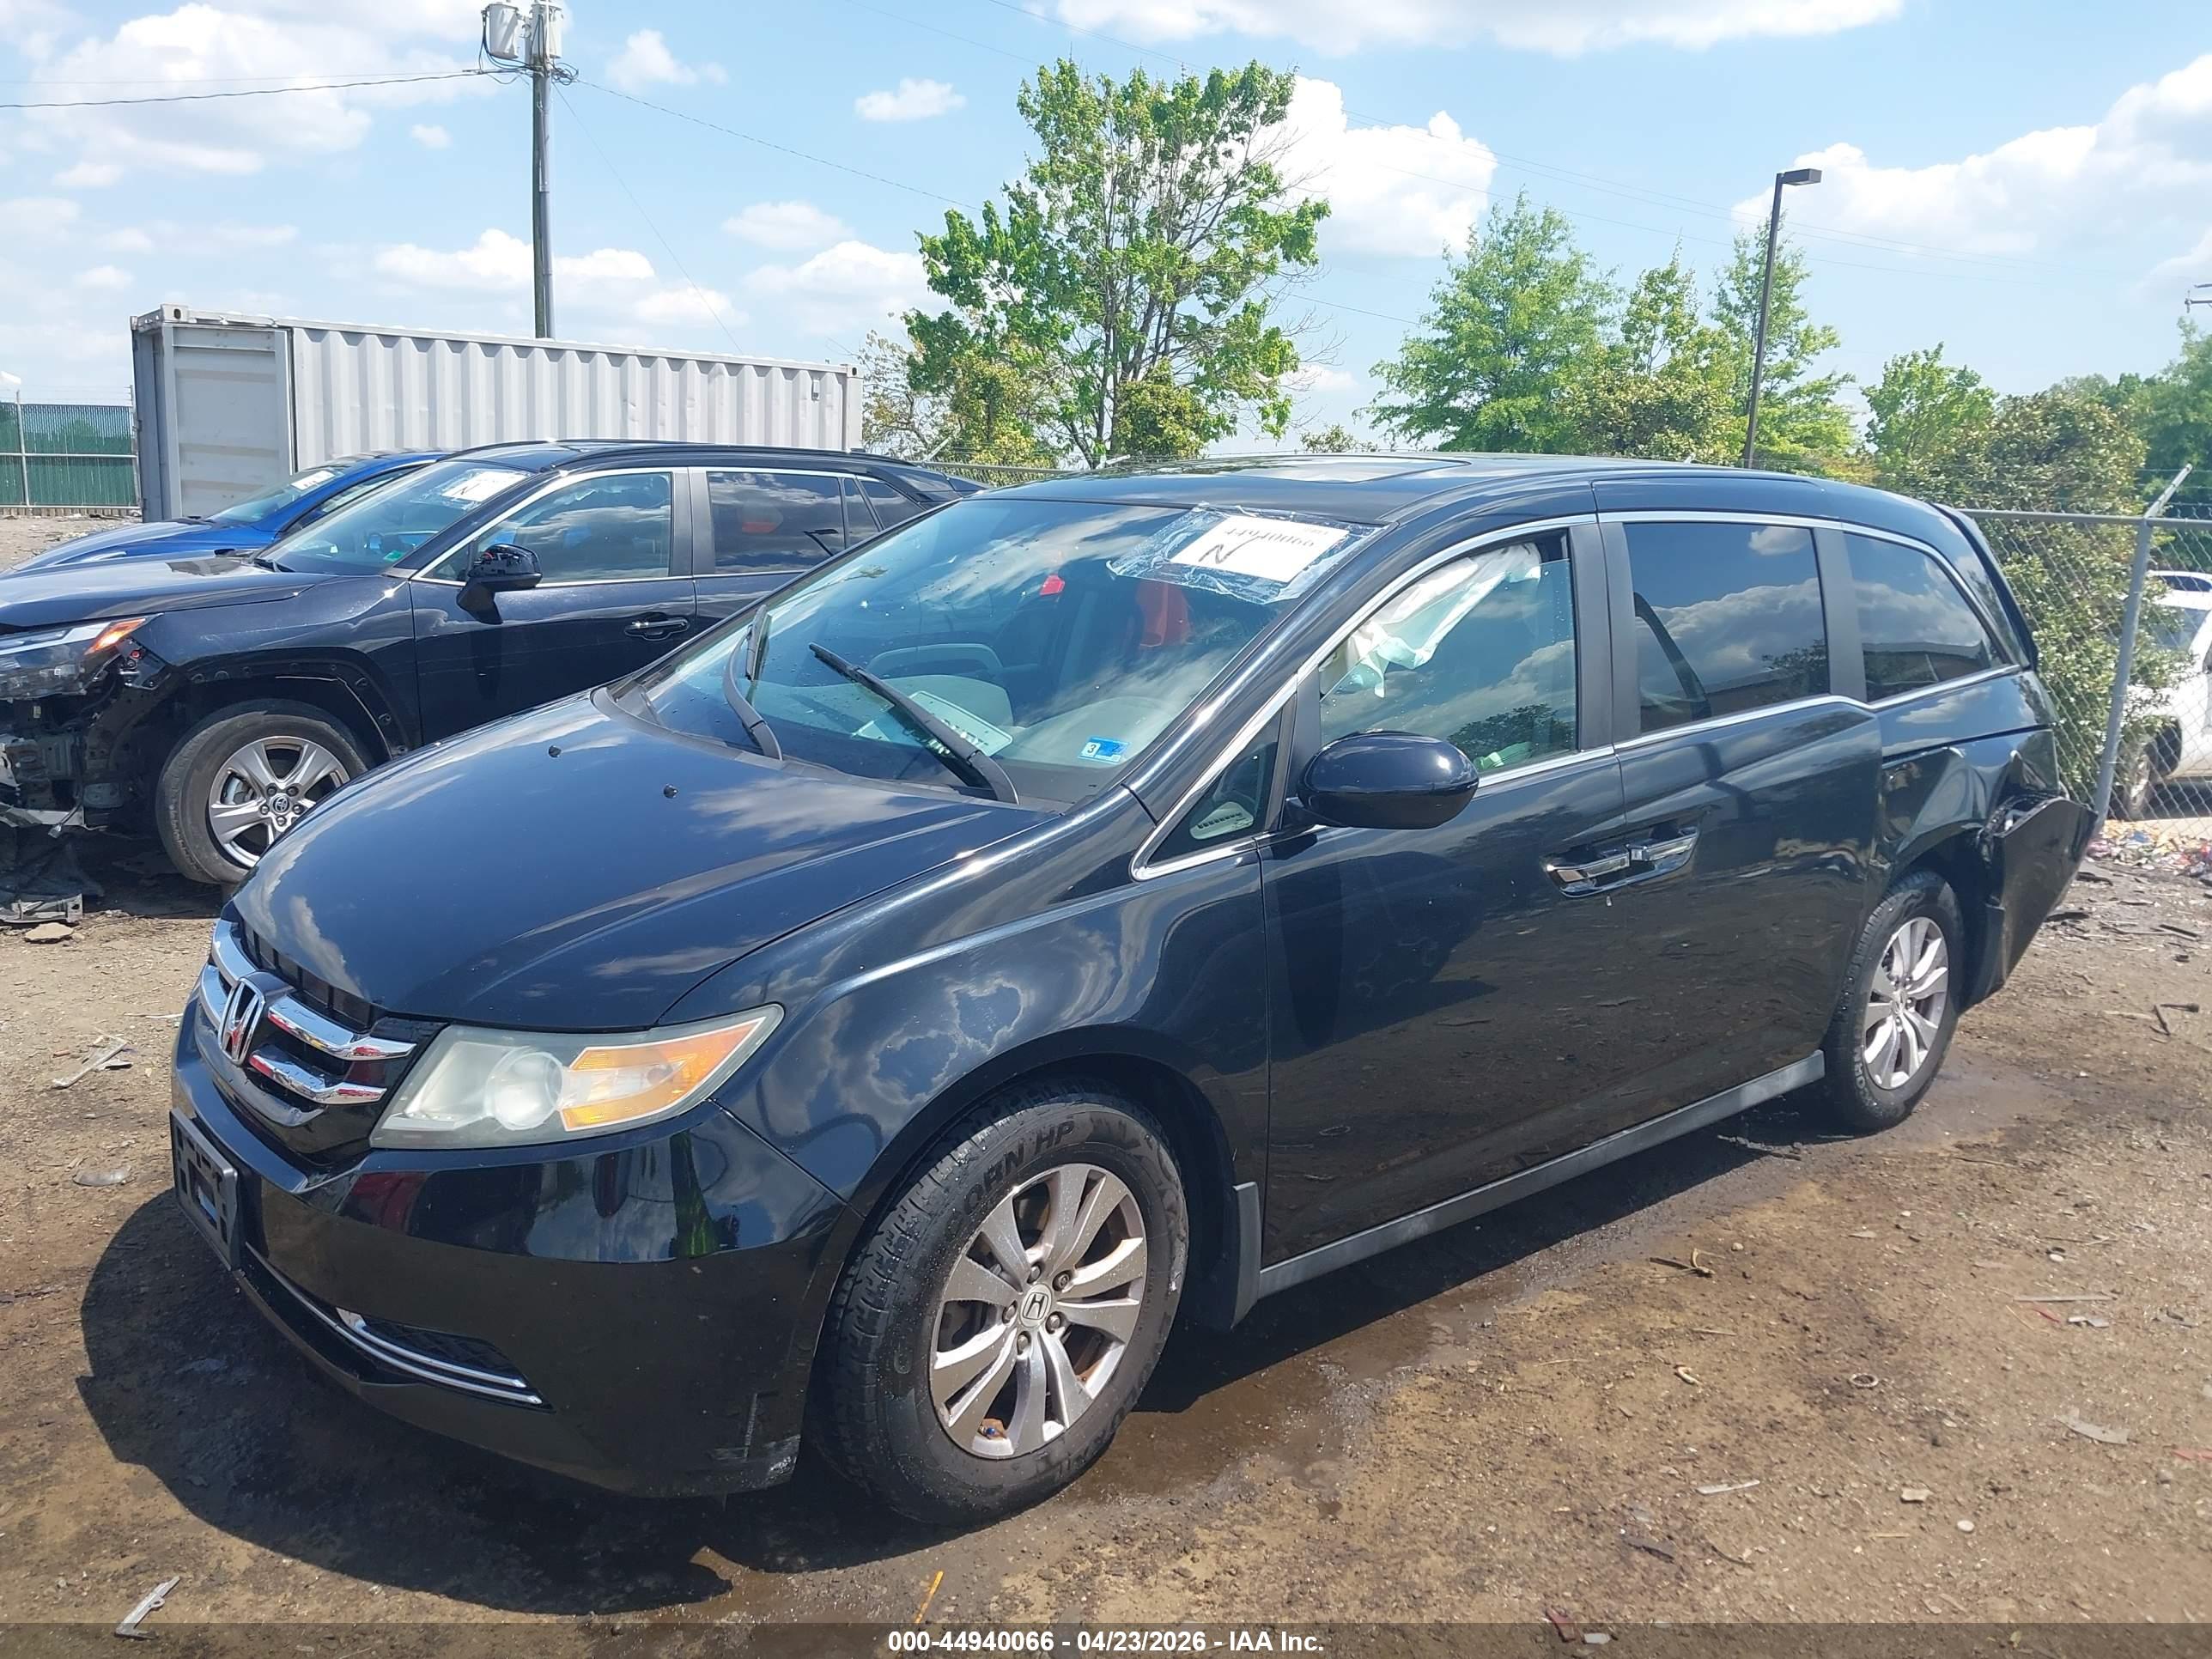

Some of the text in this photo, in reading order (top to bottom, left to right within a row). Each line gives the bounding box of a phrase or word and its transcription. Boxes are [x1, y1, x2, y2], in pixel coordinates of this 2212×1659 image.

[1198, 535, 1261, 564] N
[1087, 743, 1097, 753] 3
[1036, 1121, 1075, 1152] HP
